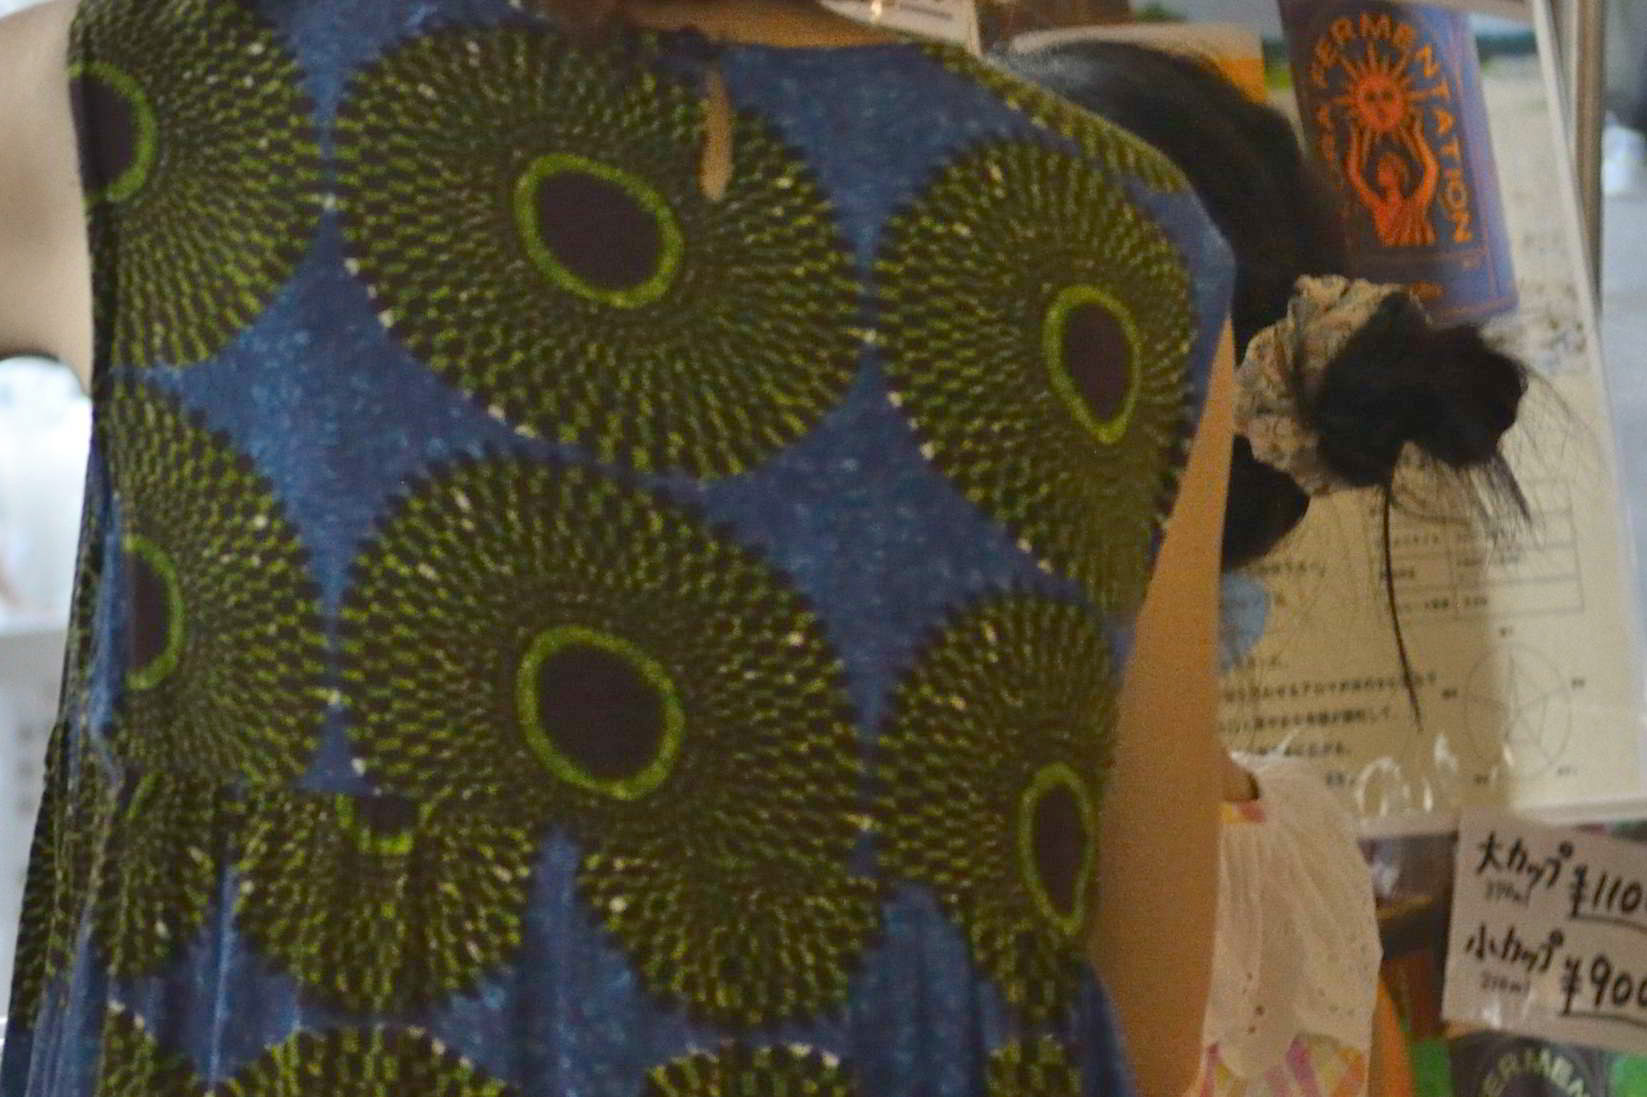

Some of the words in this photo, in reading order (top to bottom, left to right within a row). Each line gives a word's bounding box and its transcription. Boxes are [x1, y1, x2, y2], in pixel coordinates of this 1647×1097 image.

[1477, 831, 1574, 889] 大カップ
[1569, 864, 1647, 919] ¥110
